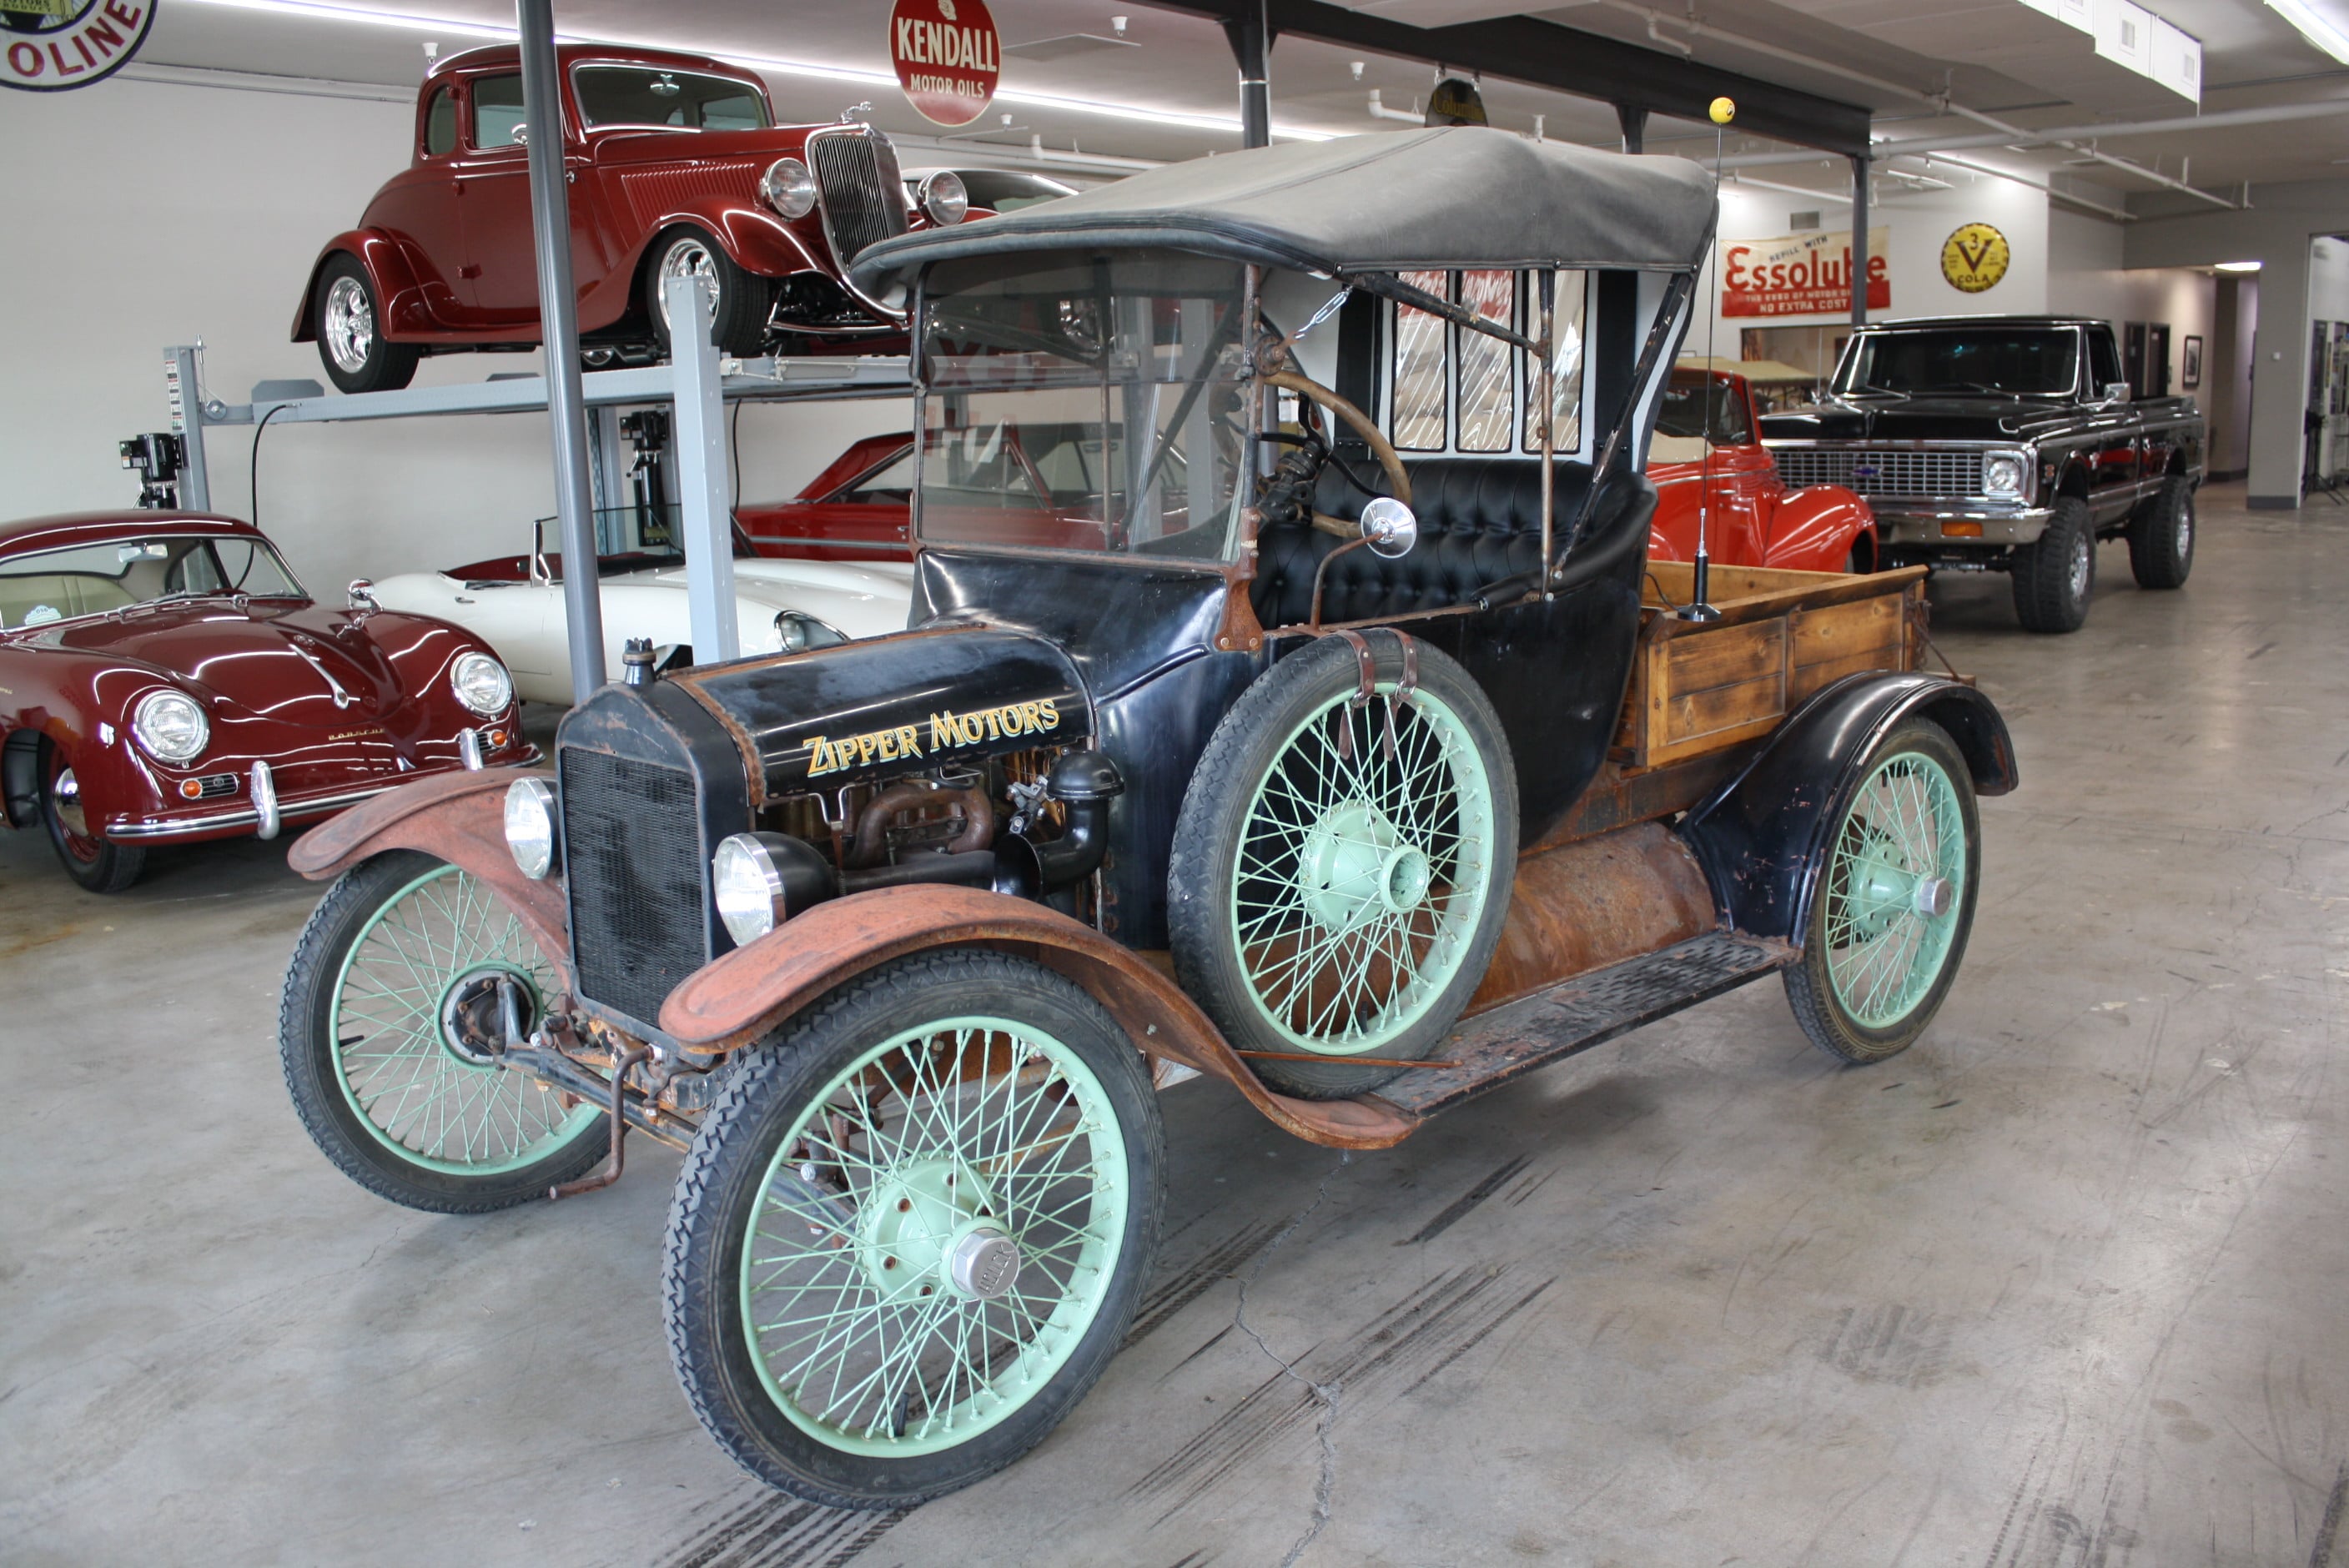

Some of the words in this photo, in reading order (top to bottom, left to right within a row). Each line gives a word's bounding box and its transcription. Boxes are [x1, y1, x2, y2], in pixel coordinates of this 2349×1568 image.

[8, 0, 142, 78] OLINE
[898, 17, 997, 73] KENDALL
[910, 73, 953, 94] MOTOR
[958, 79, 984, 98] OILS
[1769, 247, 1799, 262] REFILL
[1804, 234, 1828, 249] WITH
[1969, 233, 1979, 250] 3
[1953, 239, 1994, 274] V
[1957, 274, 1989, 284] COLA
[1746, 294, 1762, 302] THE
[1793, 292, 1803, 300] OF
[1807, 289, 1838, 299] MOTOR
[1759, 304, 1774, 313] NO
[1778, 301, 1814, 312] EXTRA
[1818, 299, 1848, 309] COST
[802, 724, 923, 778] ZIPPER
[930, 698, 1059, 753] MOTORS
